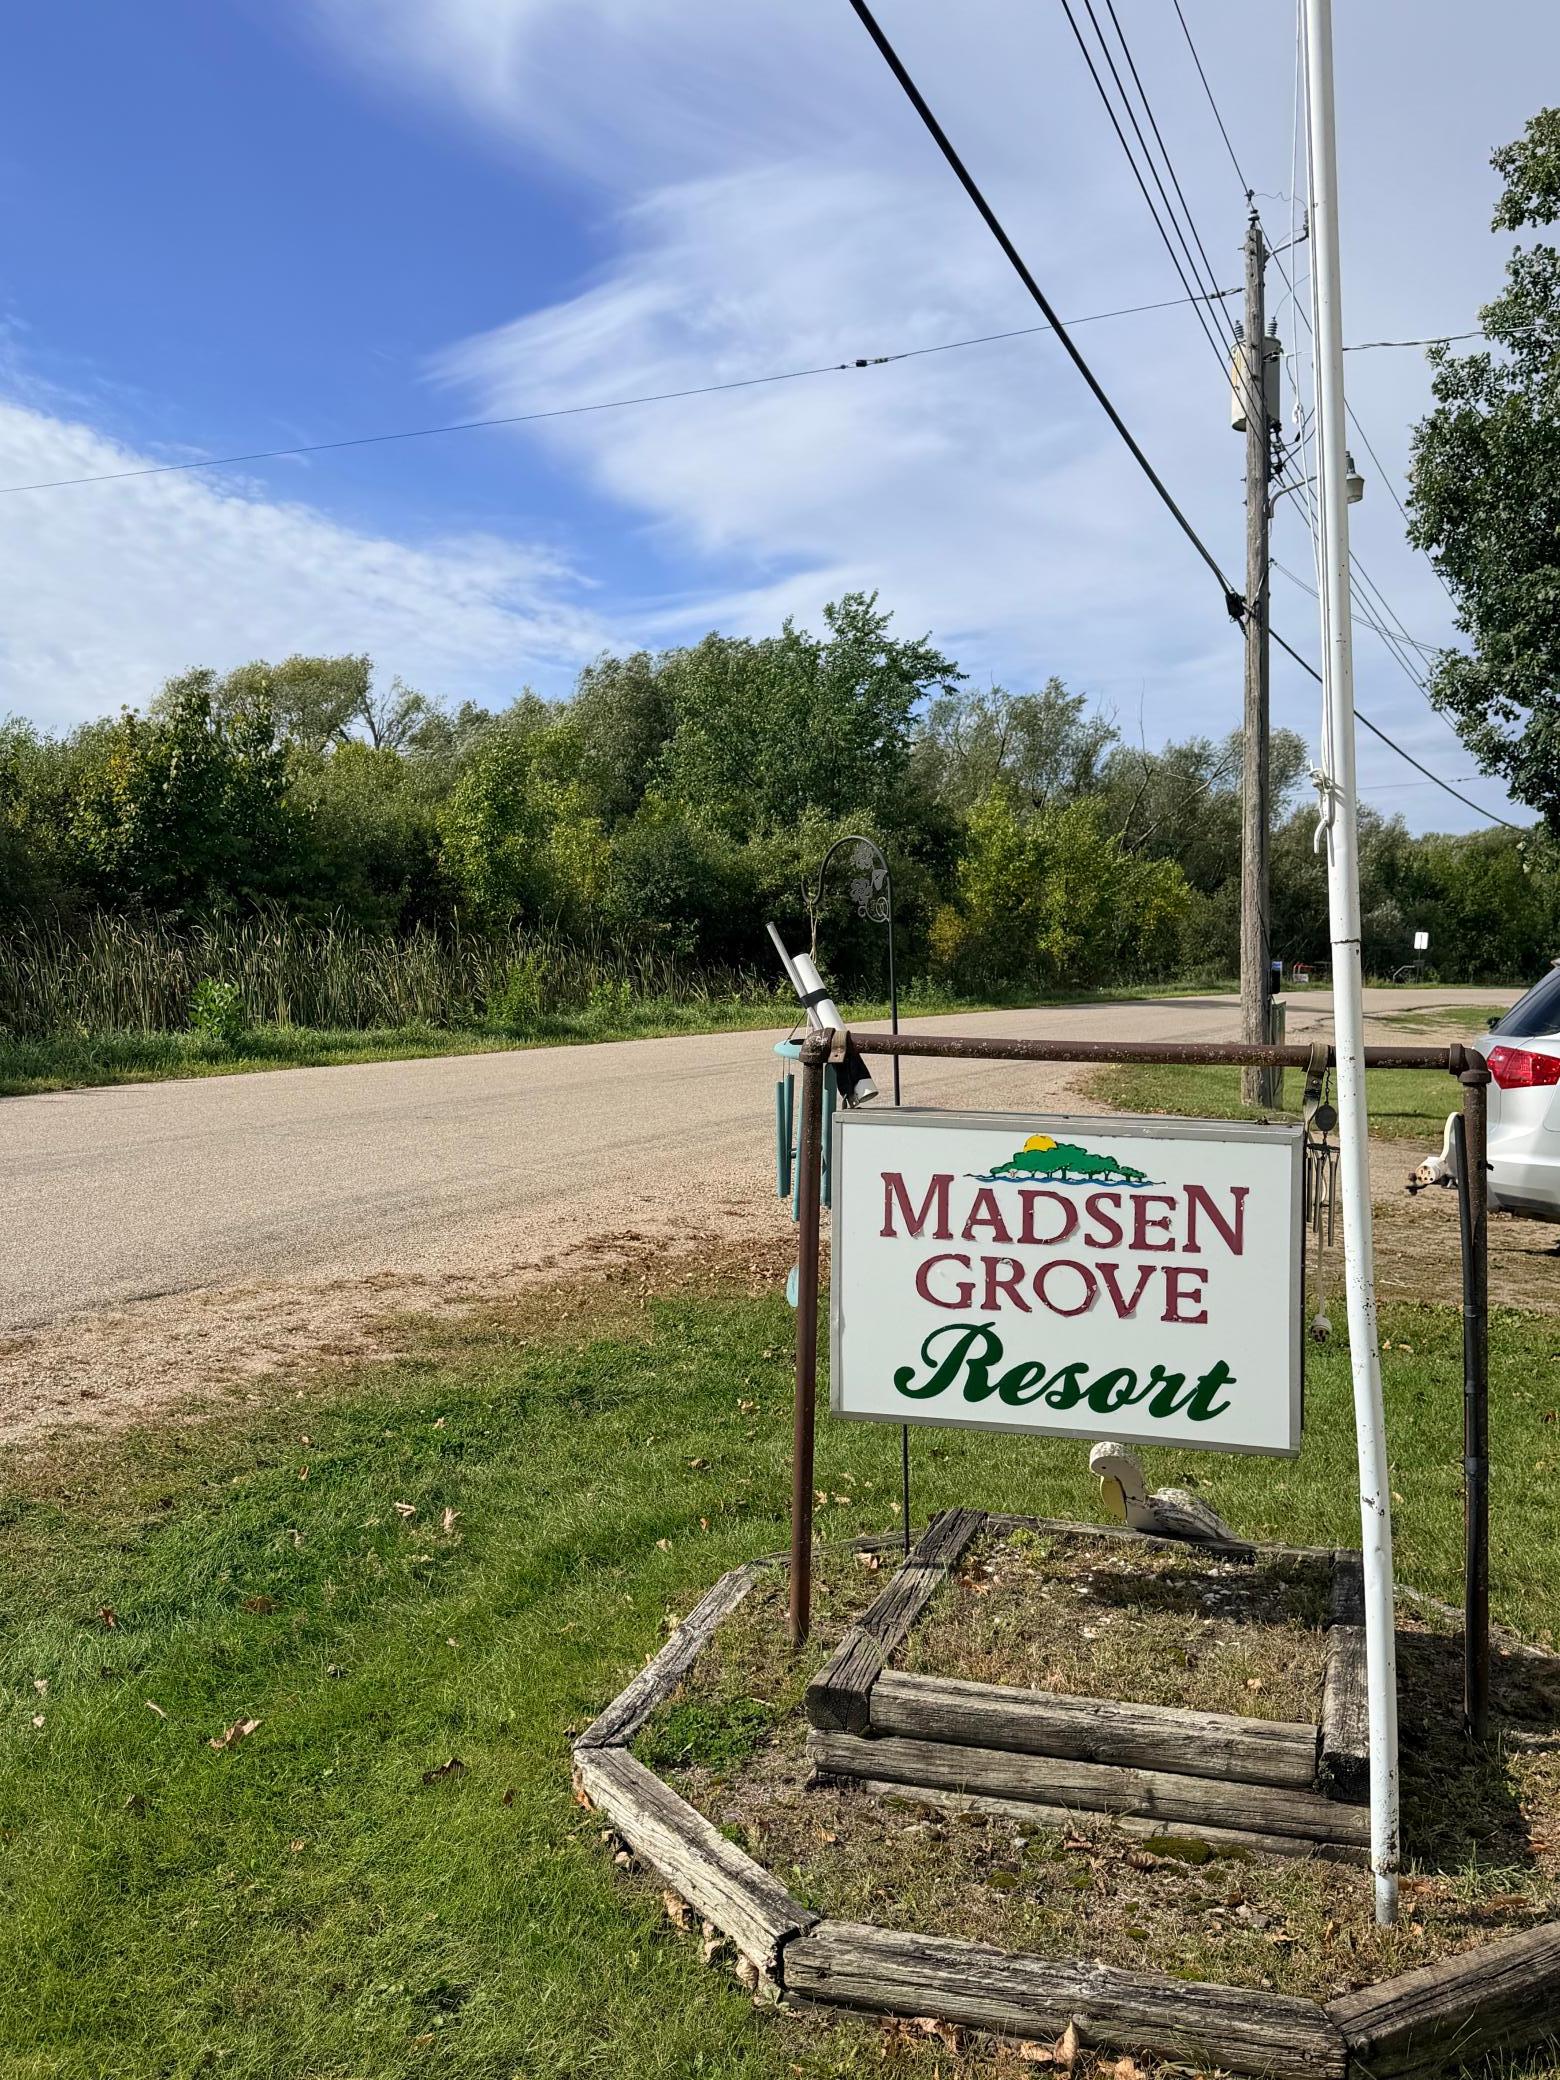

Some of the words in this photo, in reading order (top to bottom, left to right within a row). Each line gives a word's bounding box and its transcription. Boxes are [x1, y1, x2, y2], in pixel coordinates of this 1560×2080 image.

[881, 1172, 1249, 1255] MADSEN
[915, 1253, 1208, 1324] GROVE
[893, 1322, 1237, 1421] Resort
